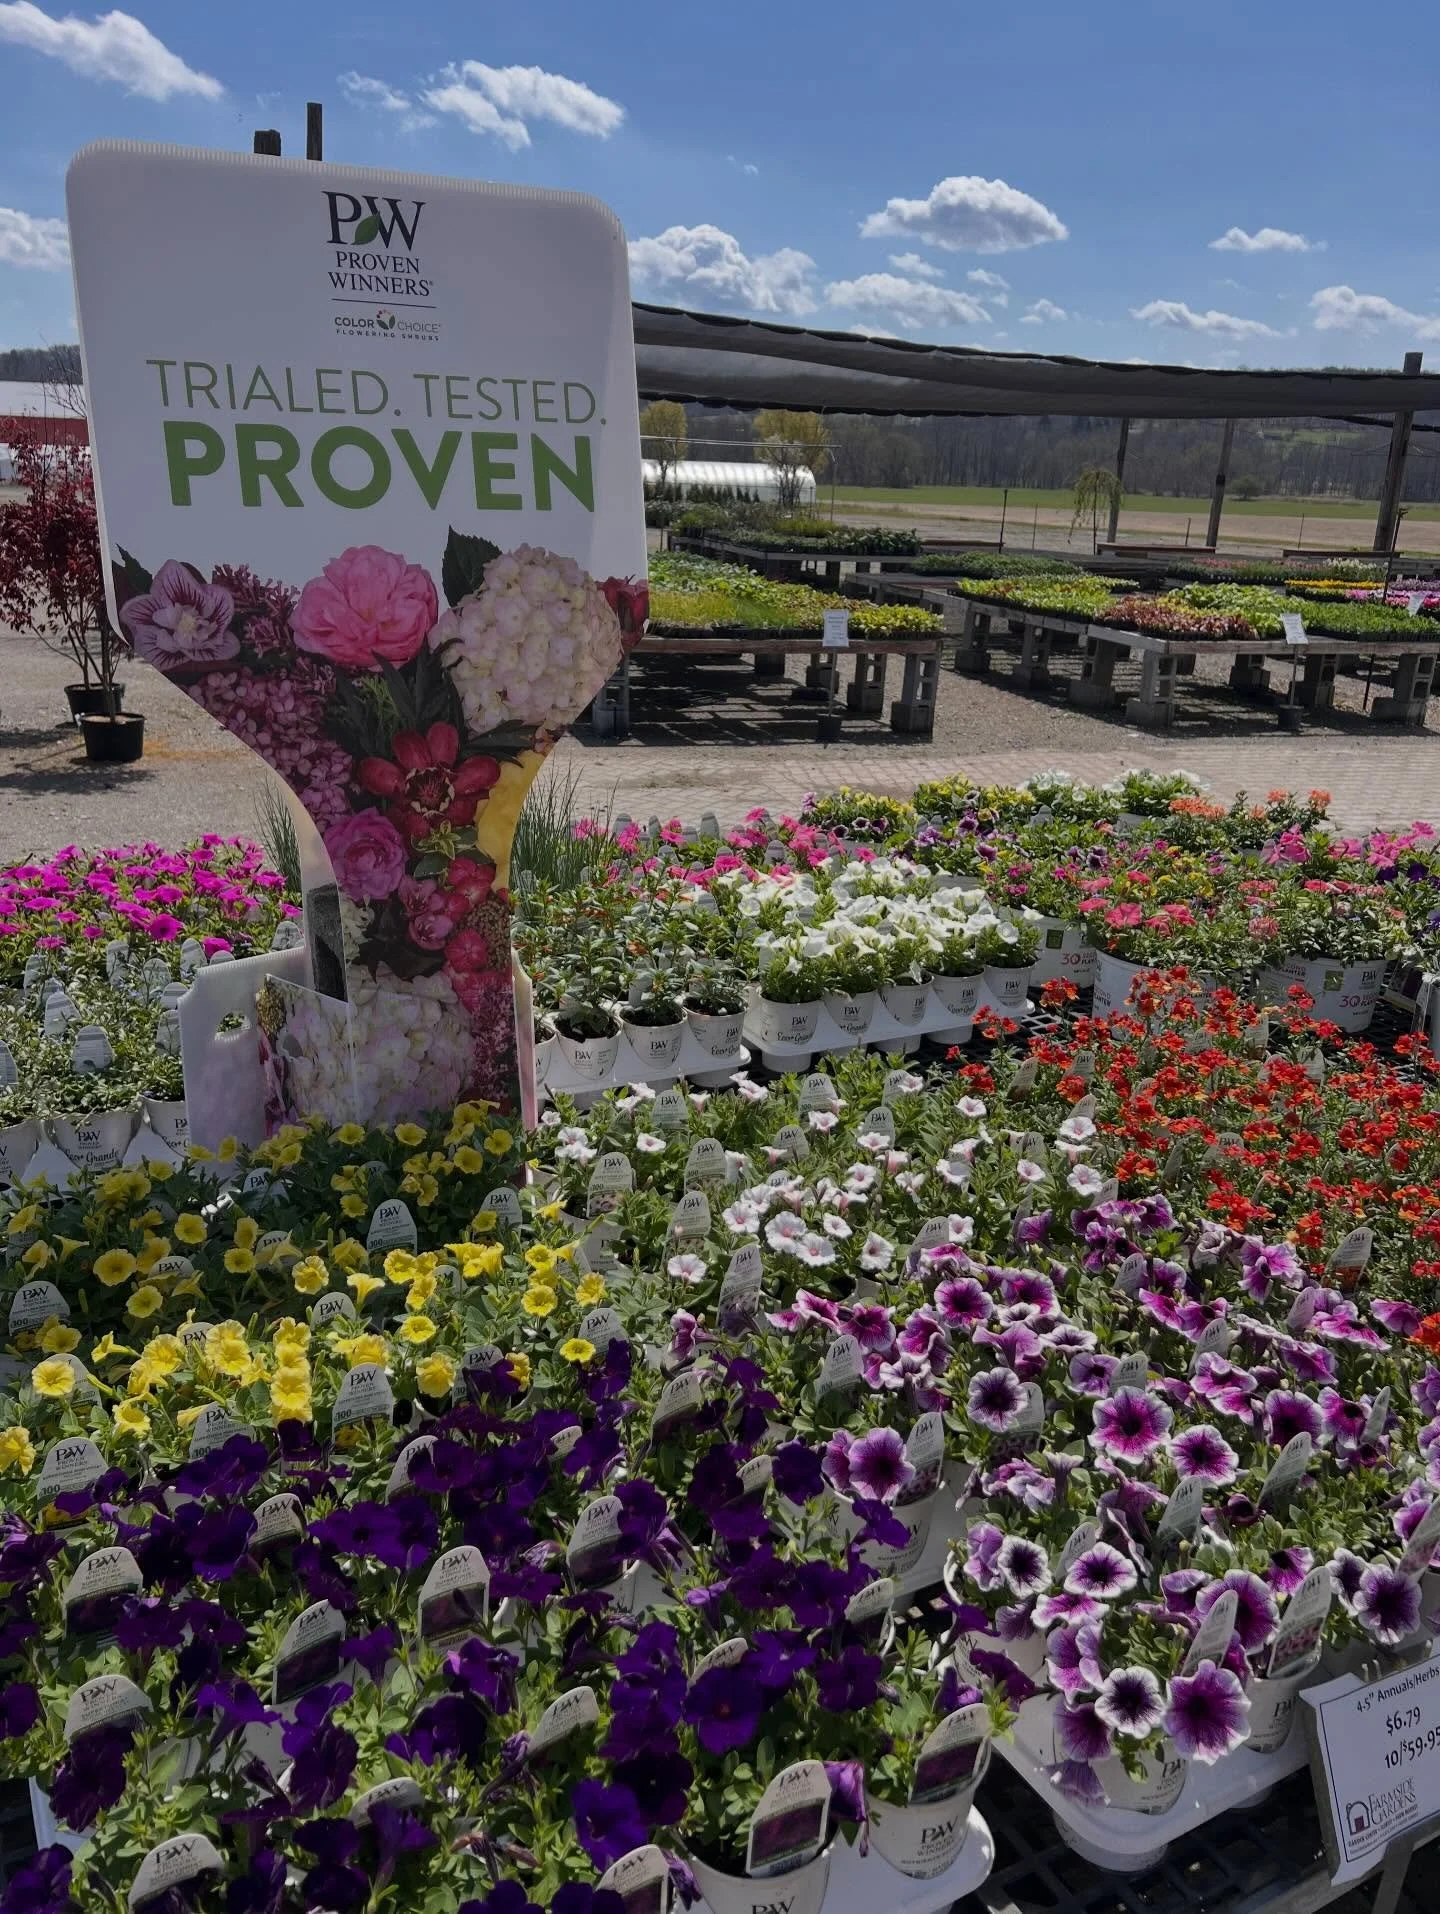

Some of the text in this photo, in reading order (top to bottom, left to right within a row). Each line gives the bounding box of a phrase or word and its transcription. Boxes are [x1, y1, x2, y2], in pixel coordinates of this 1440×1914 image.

[336, 251, 420, 275] PROVEN
[334, 316, 374, 329] COLOR
[336, 328, 440, 341] FLOWERING SHRUBS
[146, 359, 607, 425] TRIALED. TESTED.
[163, 420, 595, 513] PROVEN
[1061, 952, 1081, 965] 30
[1339, 994, 1361, 1009] 30
[78, 1130, 101, 1142] PW
[380, 1205, 402, 1219] PW
[158, 1260, 185, 1272] PW
[22, 1286, 50, 1300] PW
[320, 1299, 344, 1316] PW
[587, 1313, 610, 1330] PW
[469, 1351, 494, 1365] PW
[350, 1369, 377, 1386] PW
[56, 1444, 87, 1461] PW
[262, 1498, 292, 1518] PW
[88, 1551, 122, 1571] PW
[441, 1551, 472, 1570] PW
[80, 1678, 118, 1702] PW
[1377, 1666, 1440, 1702] Annuals/Herbs
[1386, 1706, 1421, 1736] $6.79
[1370, 1791, 1417, 1825] GARDENS
[921, 1815, 958, 1843] PW
[155, 1838, 198, 1864] PW
